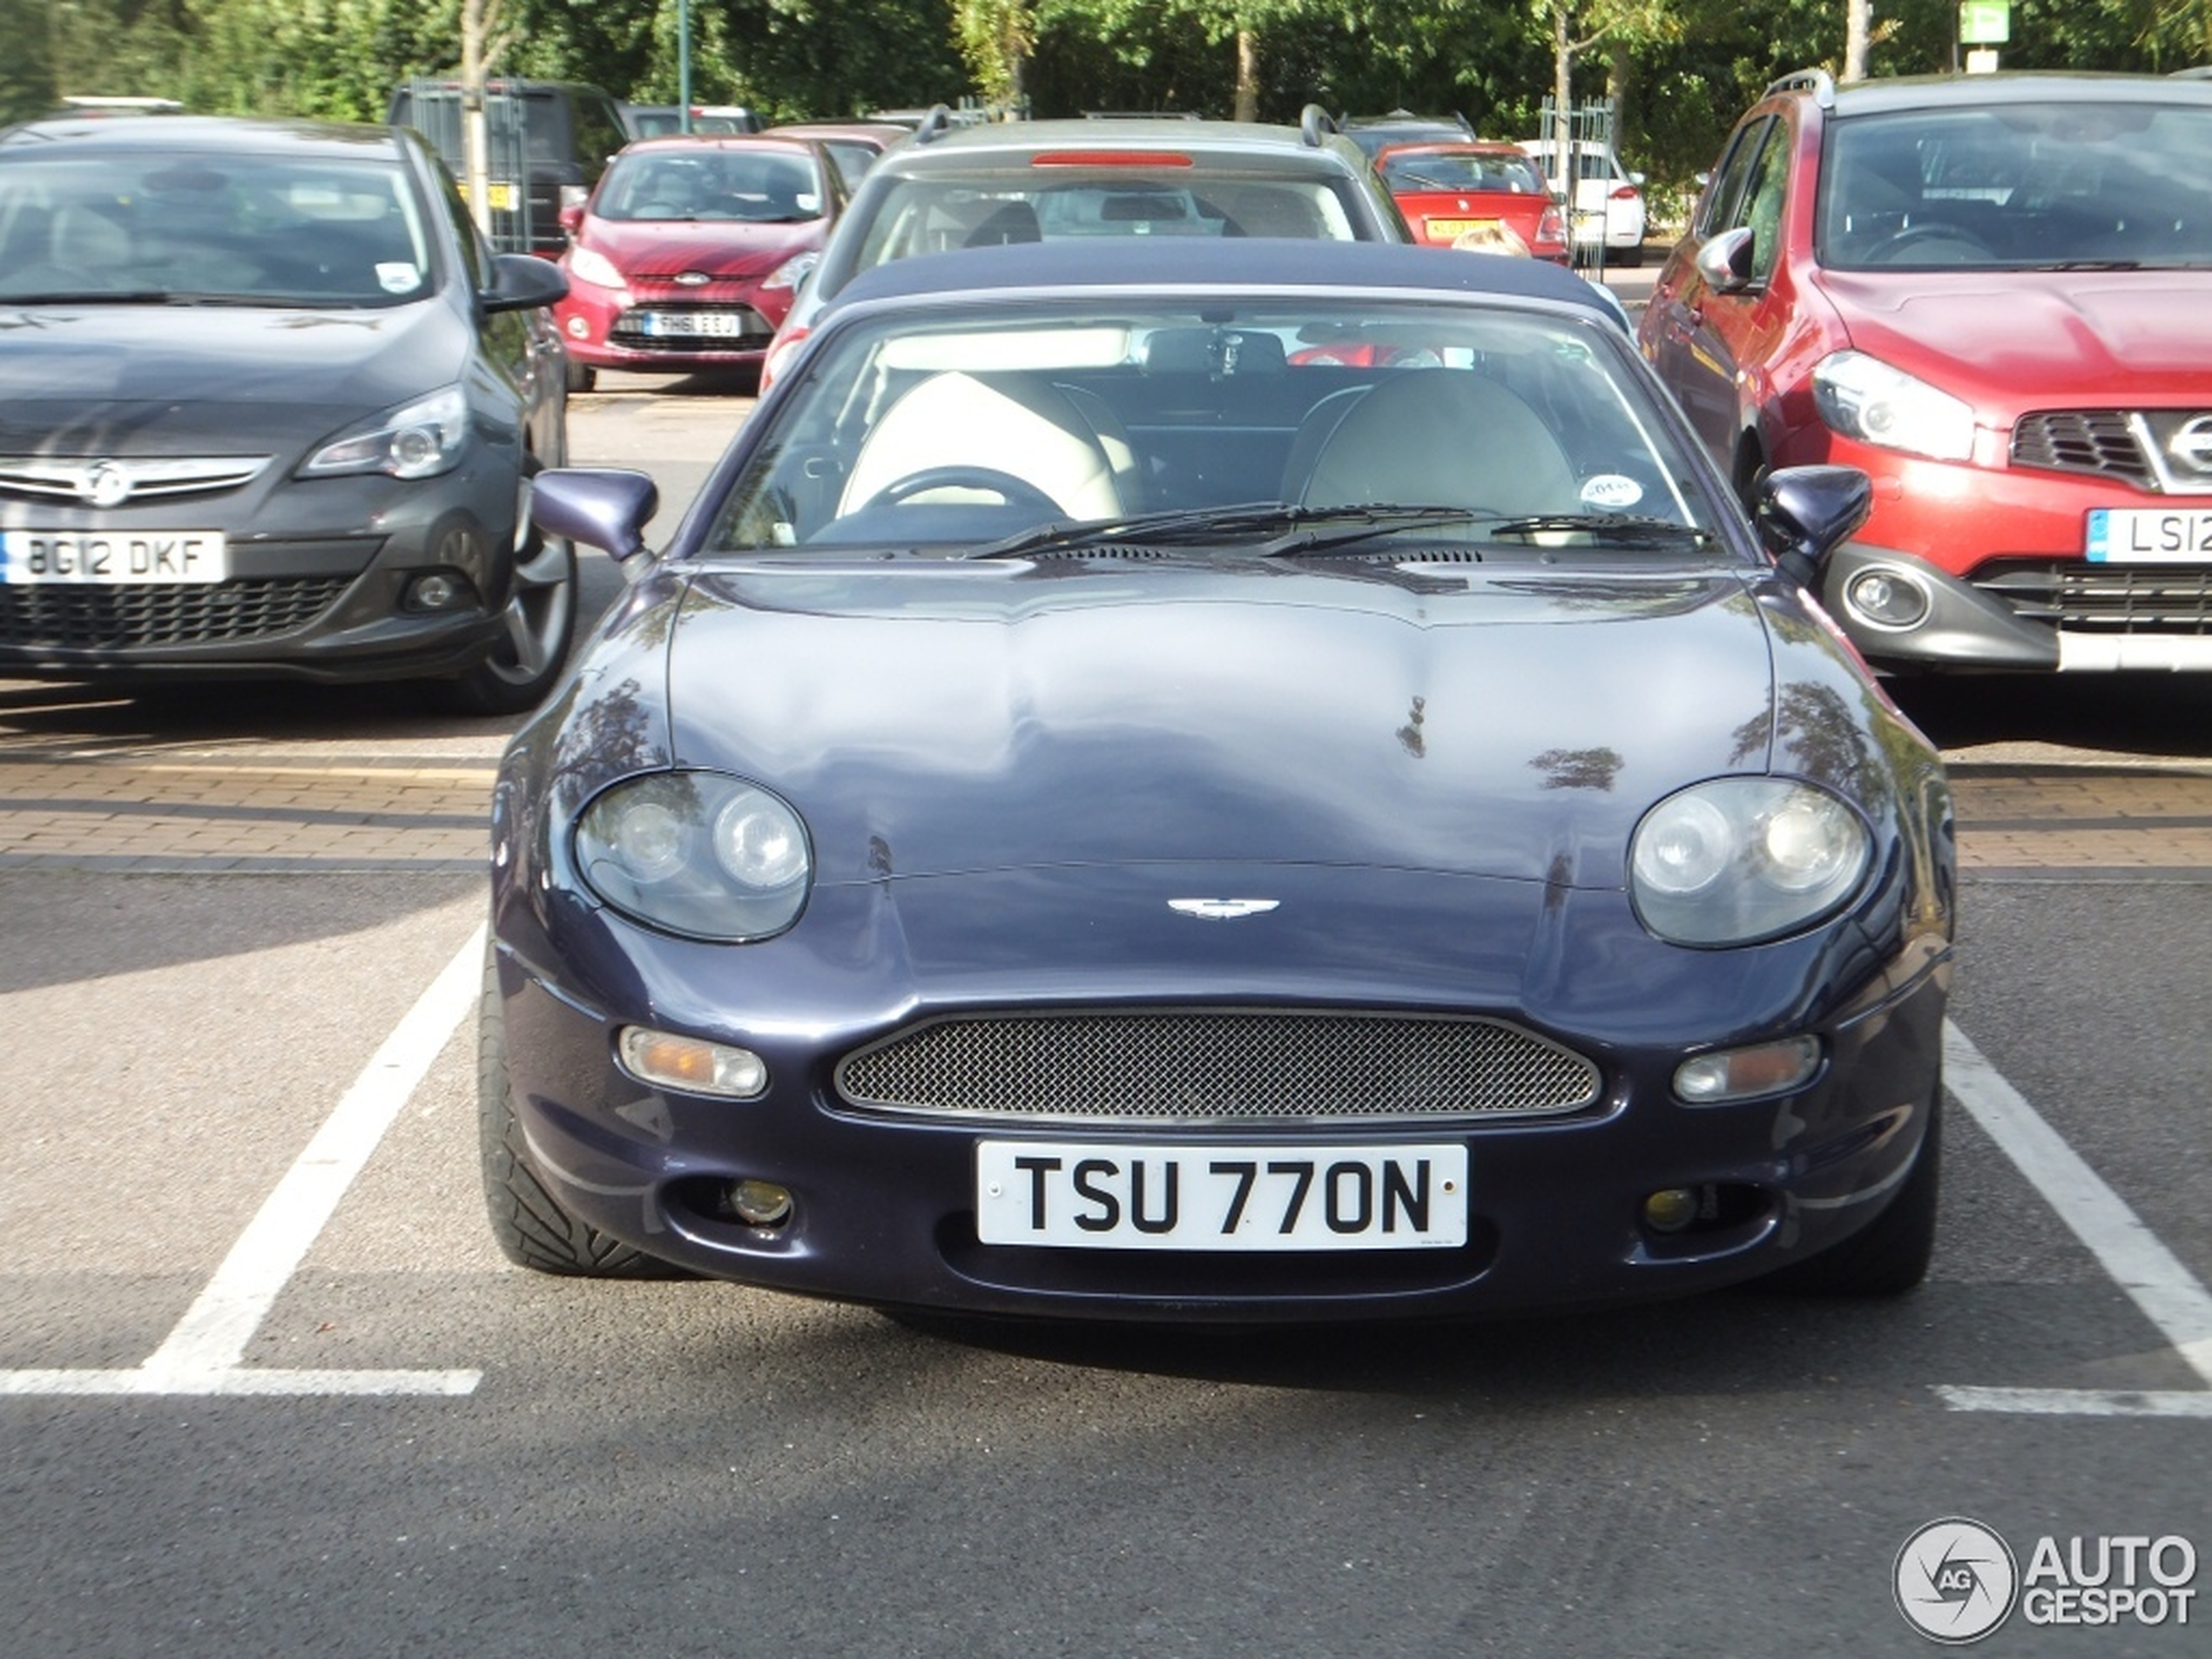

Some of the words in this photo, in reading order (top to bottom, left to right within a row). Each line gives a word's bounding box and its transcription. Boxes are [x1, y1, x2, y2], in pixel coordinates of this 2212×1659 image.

[30, 540, 111, 575] BG12
[130, 540, 203, 575] DKF
[1015, 1157, 1178, 1233] TSU
[1209, 1159, 1431, 1234] 770N
